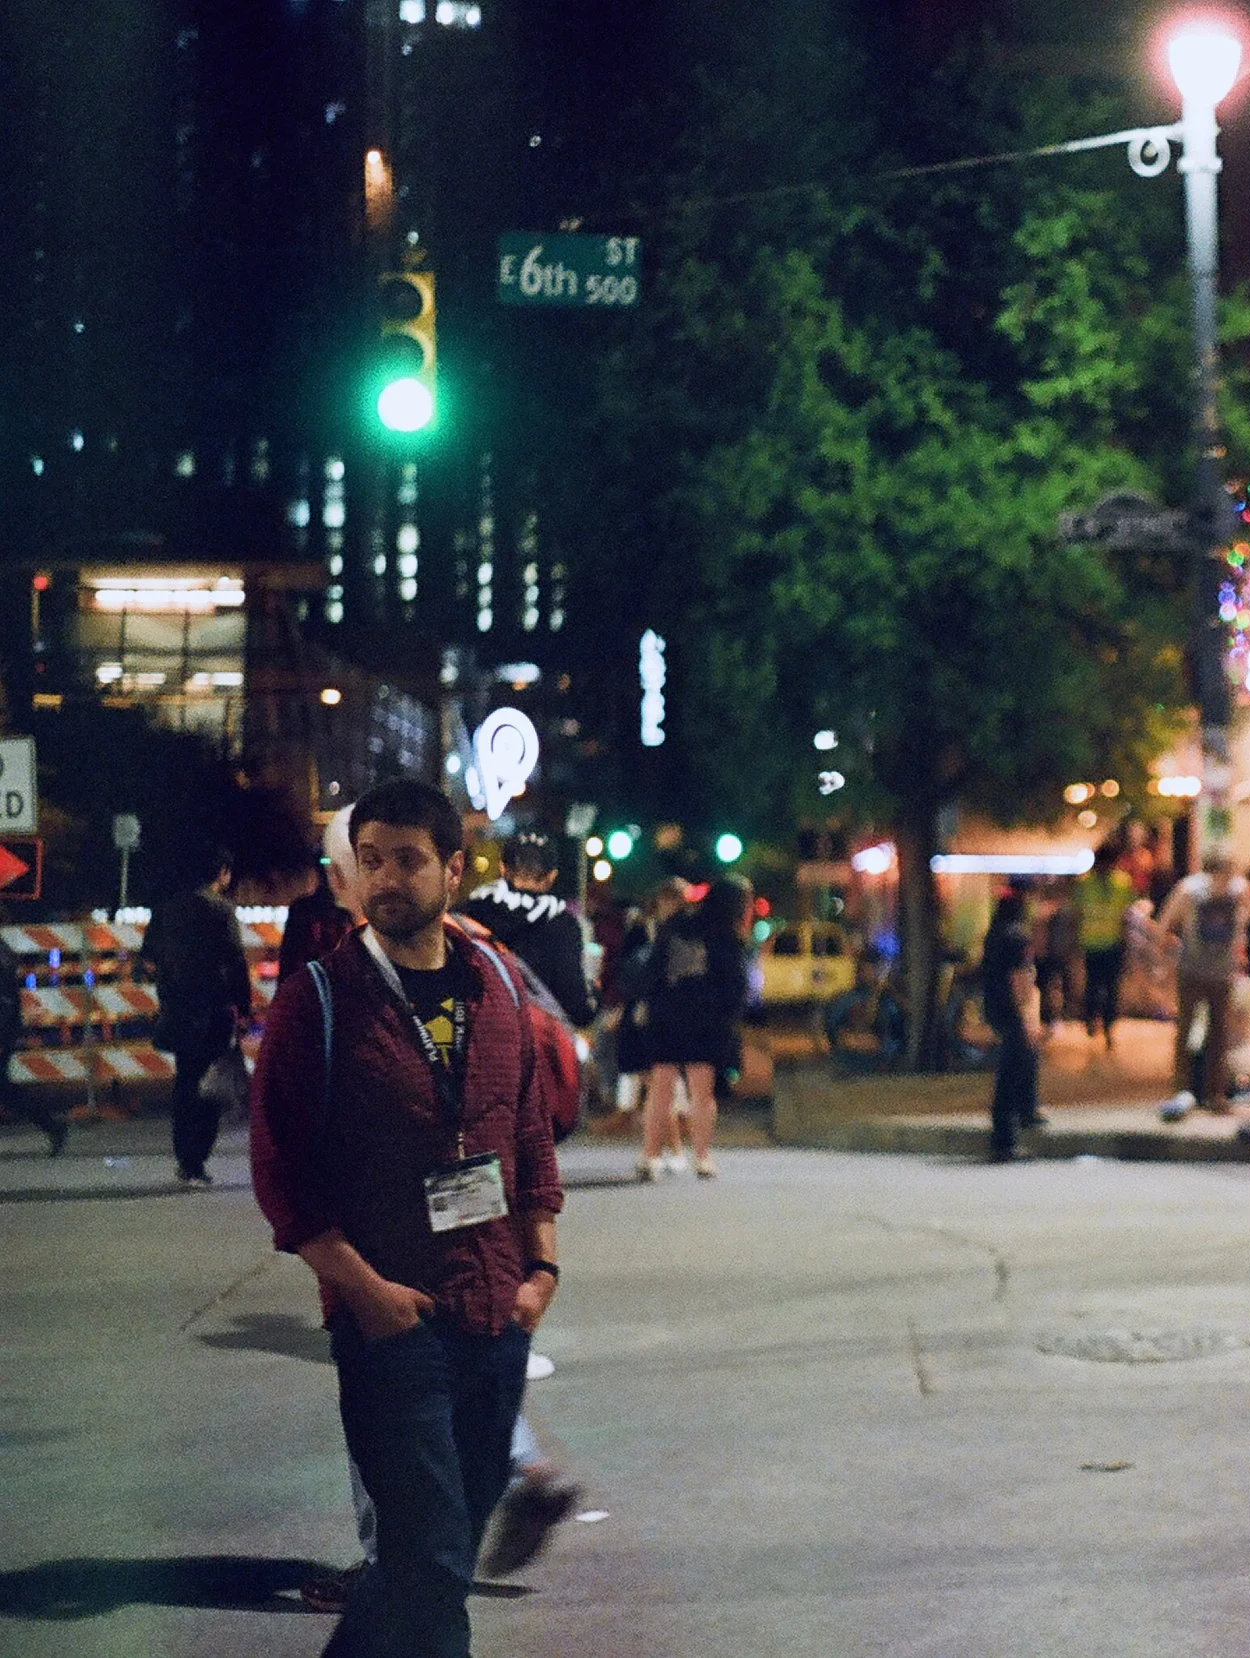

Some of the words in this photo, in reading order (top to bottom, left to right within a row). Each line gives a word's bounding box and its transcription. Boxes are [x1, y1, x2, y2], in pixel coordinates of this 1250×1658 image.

[606, 237, 640, 266] ST
[500, 254, 517, 285] E
[519, 244, 578, 296] 6th
[585, 274, 638, 304] 500
